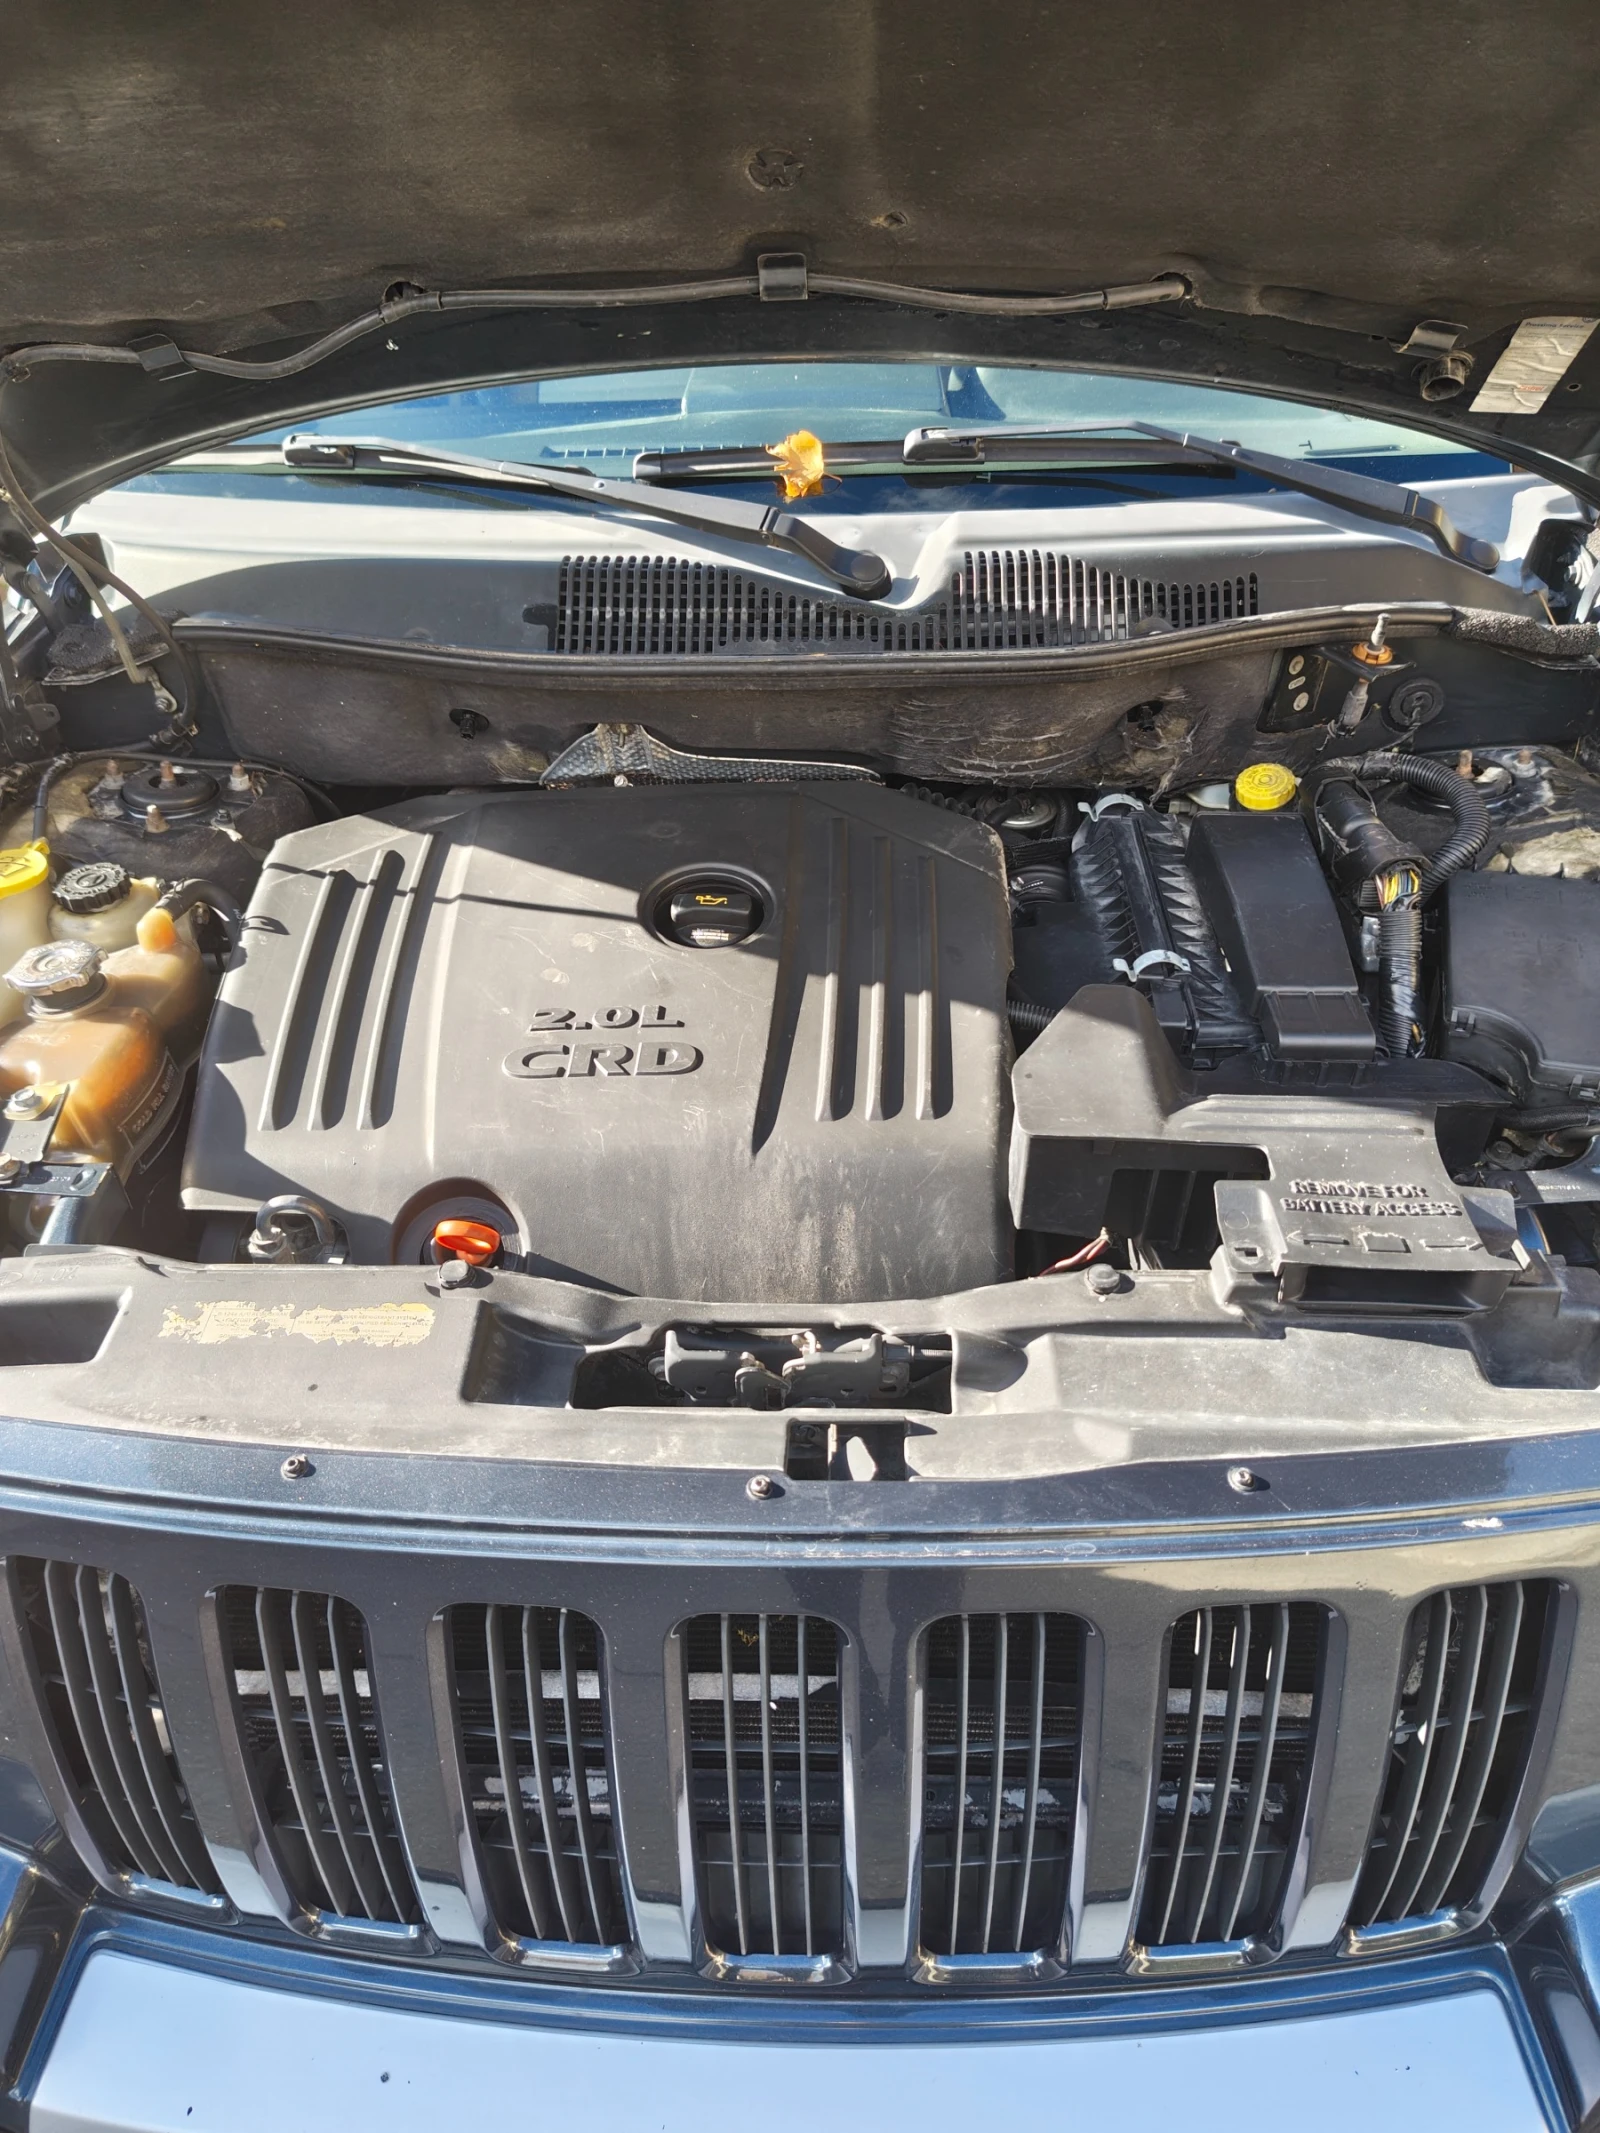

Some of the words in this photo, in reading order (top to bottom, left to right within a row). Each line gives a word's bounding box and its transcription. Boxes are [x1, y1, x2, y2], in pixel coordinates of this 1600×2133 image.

[530, 1005, 685, 1032] 2.0L
[502, 1041, 704, 1079] CRD
[1289, 1179, 1381, 1198] REMOVE
[1381, 1183, 1429, 1198] FOR
[1280, 1198, 1371, 1216] BATTERY
[1373, 1202, 1463, 1217] ACCESS
